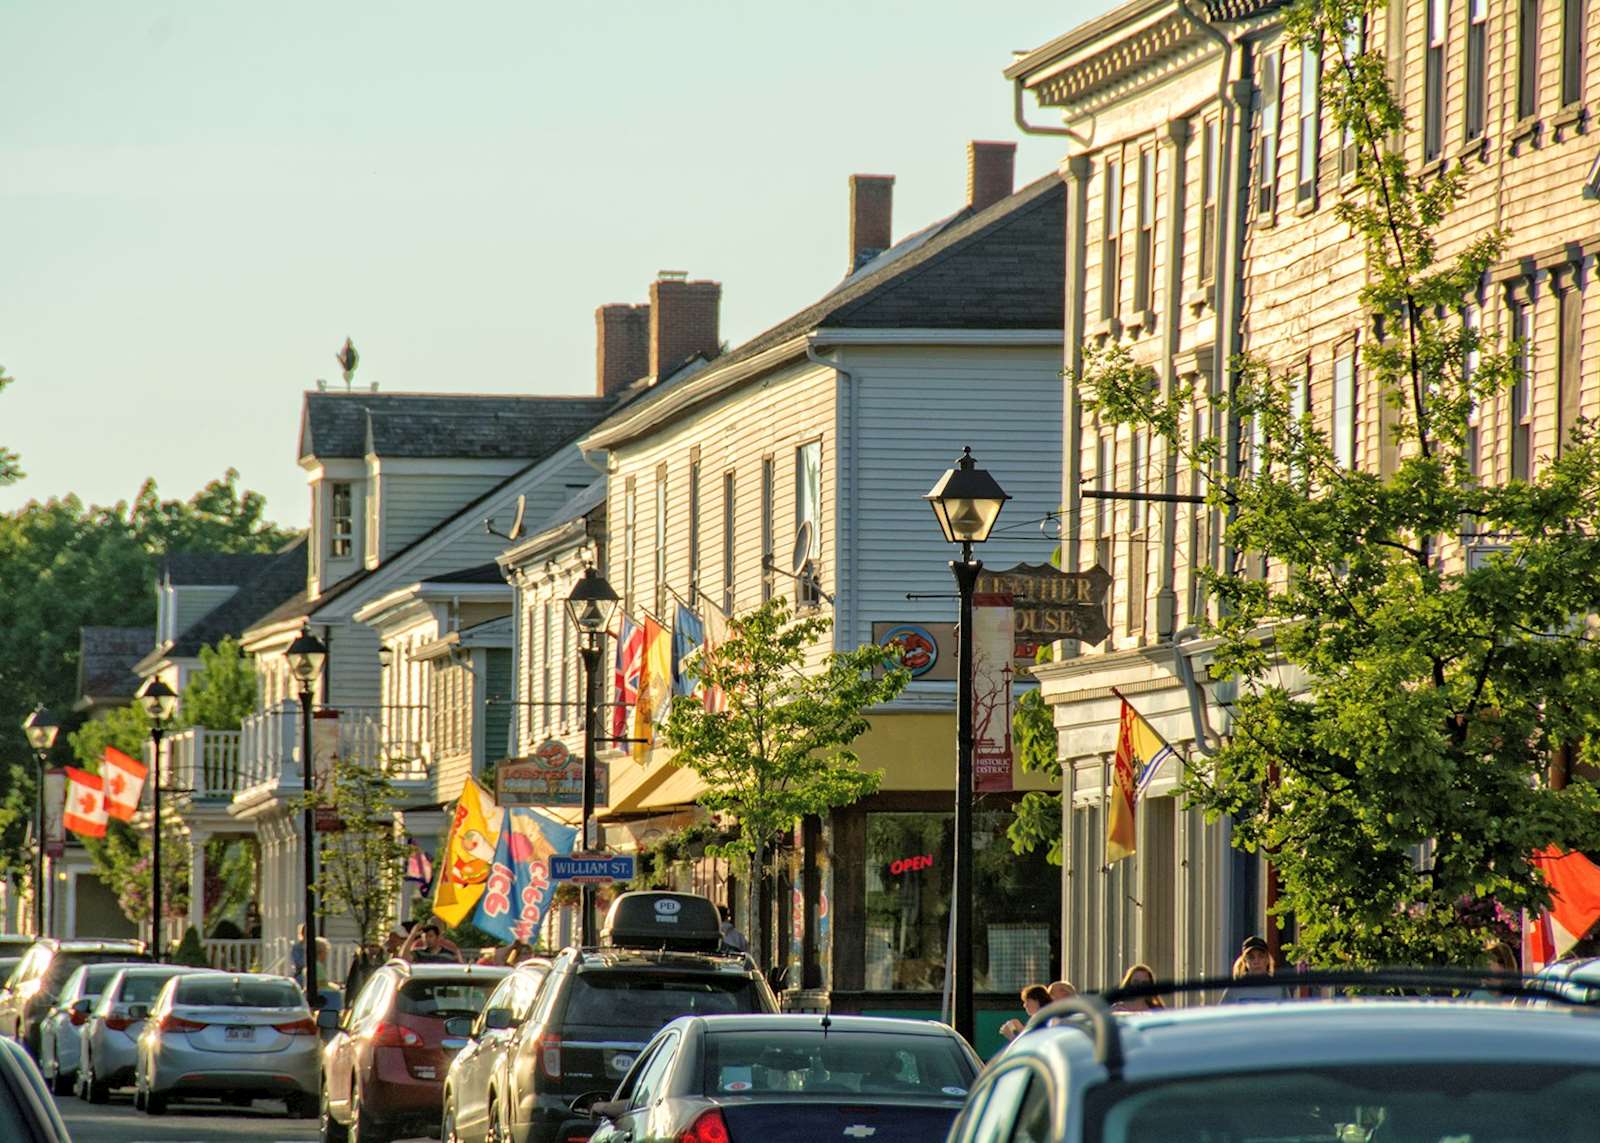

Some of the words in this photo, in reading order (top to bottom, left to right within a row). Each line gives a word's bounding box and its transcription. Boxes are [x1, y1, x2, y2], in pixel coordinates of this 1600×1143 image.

[1014, 608, 1075, 633] OUSE
[555, 862, 607, 874] WILLIAM
[611, 862, 630, 874] ST.
[890, 853, 933, 875] OPEN
[660, 902, 675, 910] PEI
